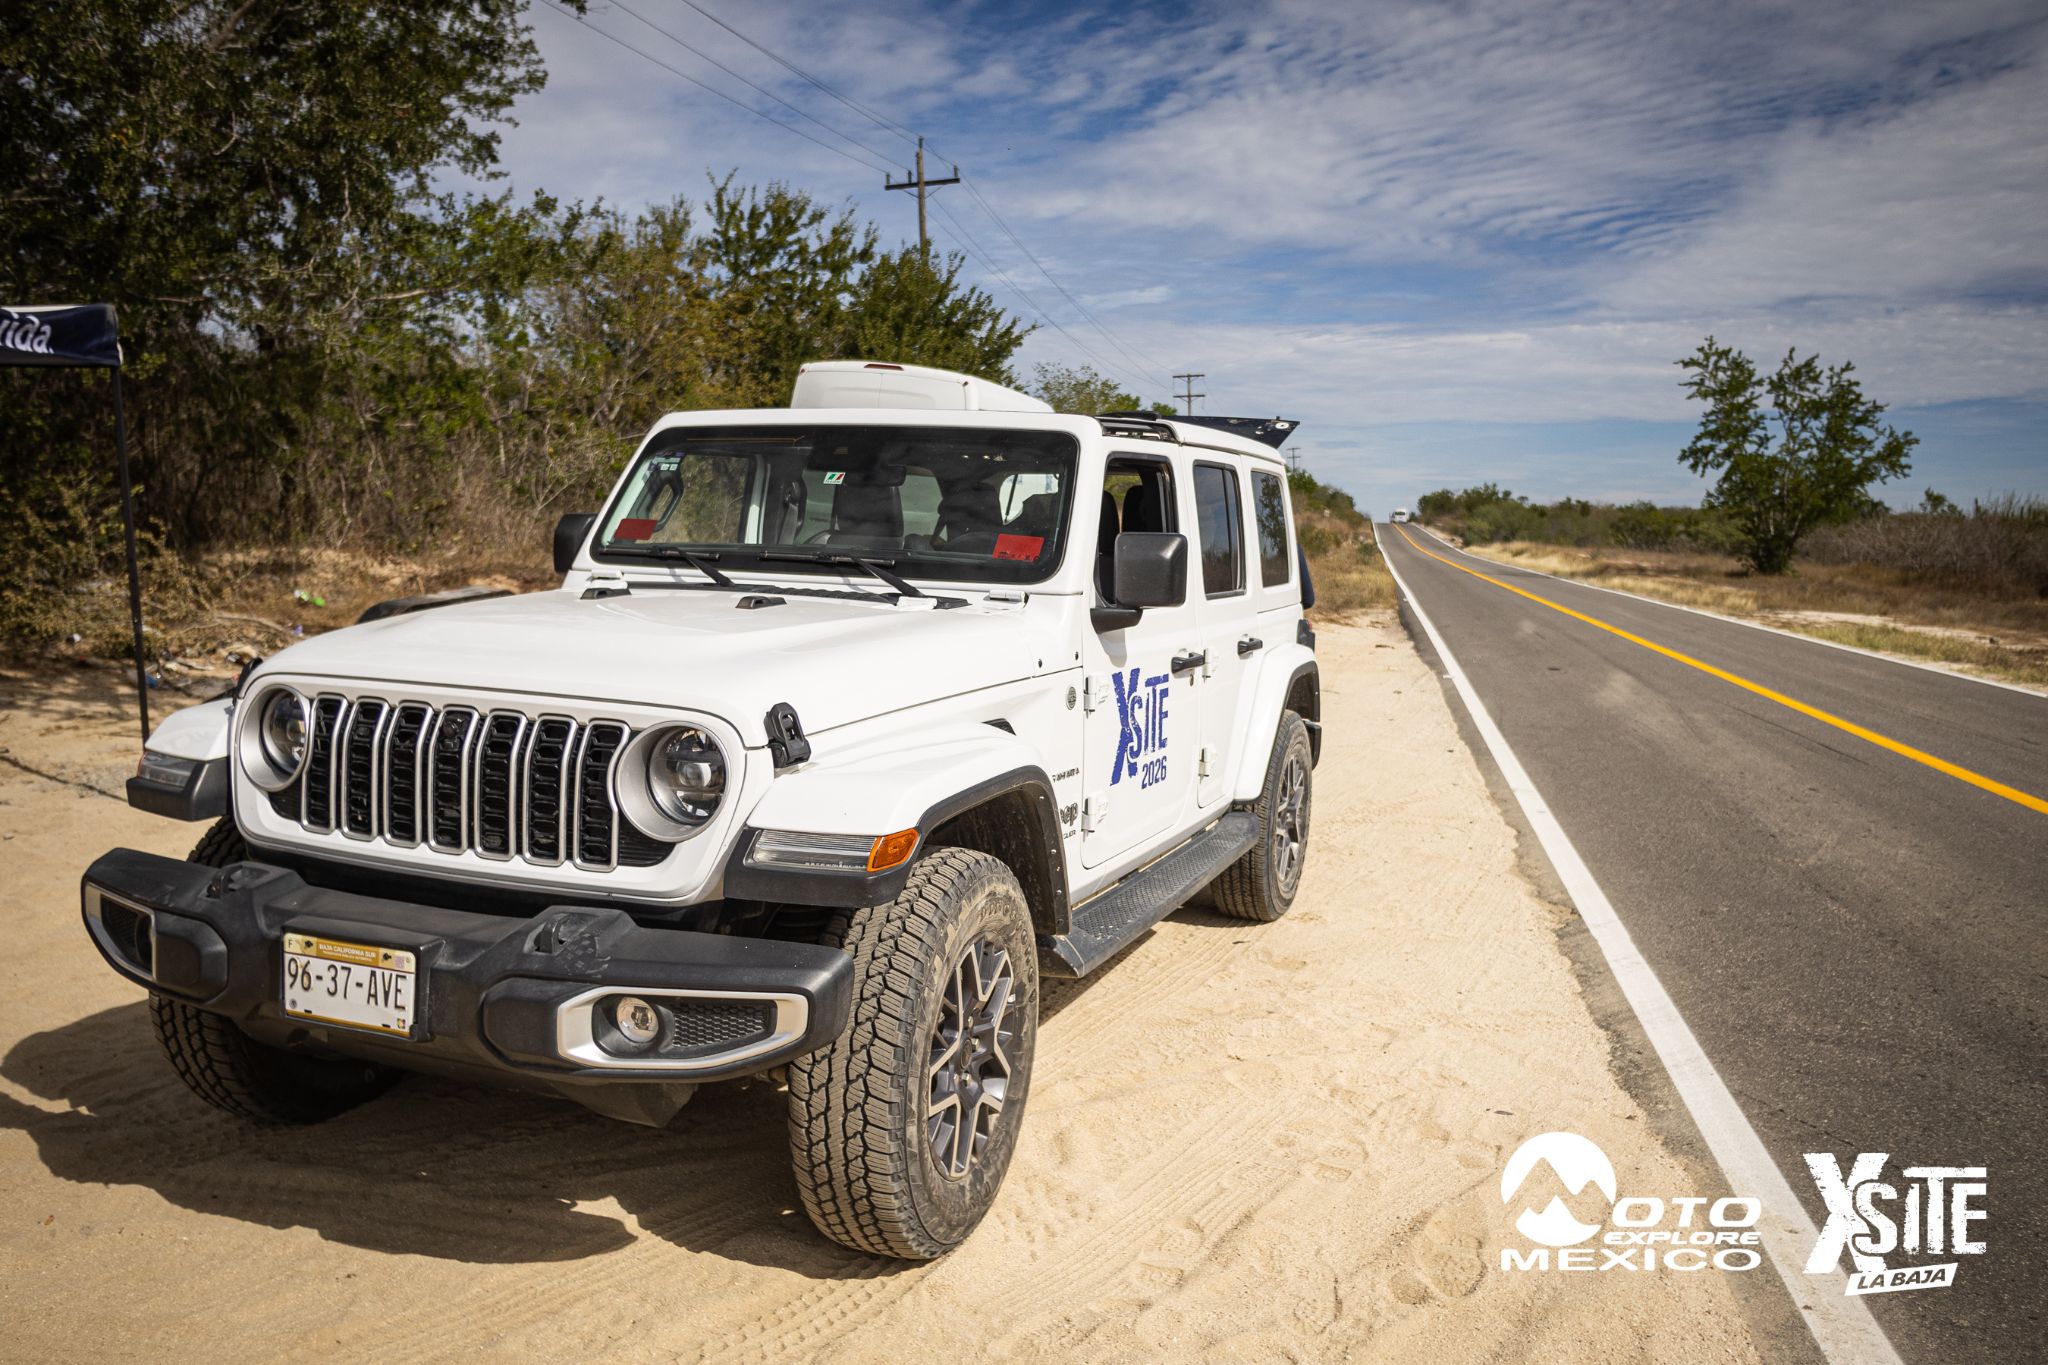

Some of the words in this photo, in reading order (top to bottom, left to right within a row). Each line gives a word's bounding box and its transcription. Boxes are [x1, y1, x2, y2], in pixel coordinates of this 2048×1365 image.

[1110, 667, 1169, 786] XSITE
[1141, 756, 1167, 789] 2026
[333, 946, 364, 957] CALIFORNIA
[287, 957, 407, 1011] 96-37-AVE
